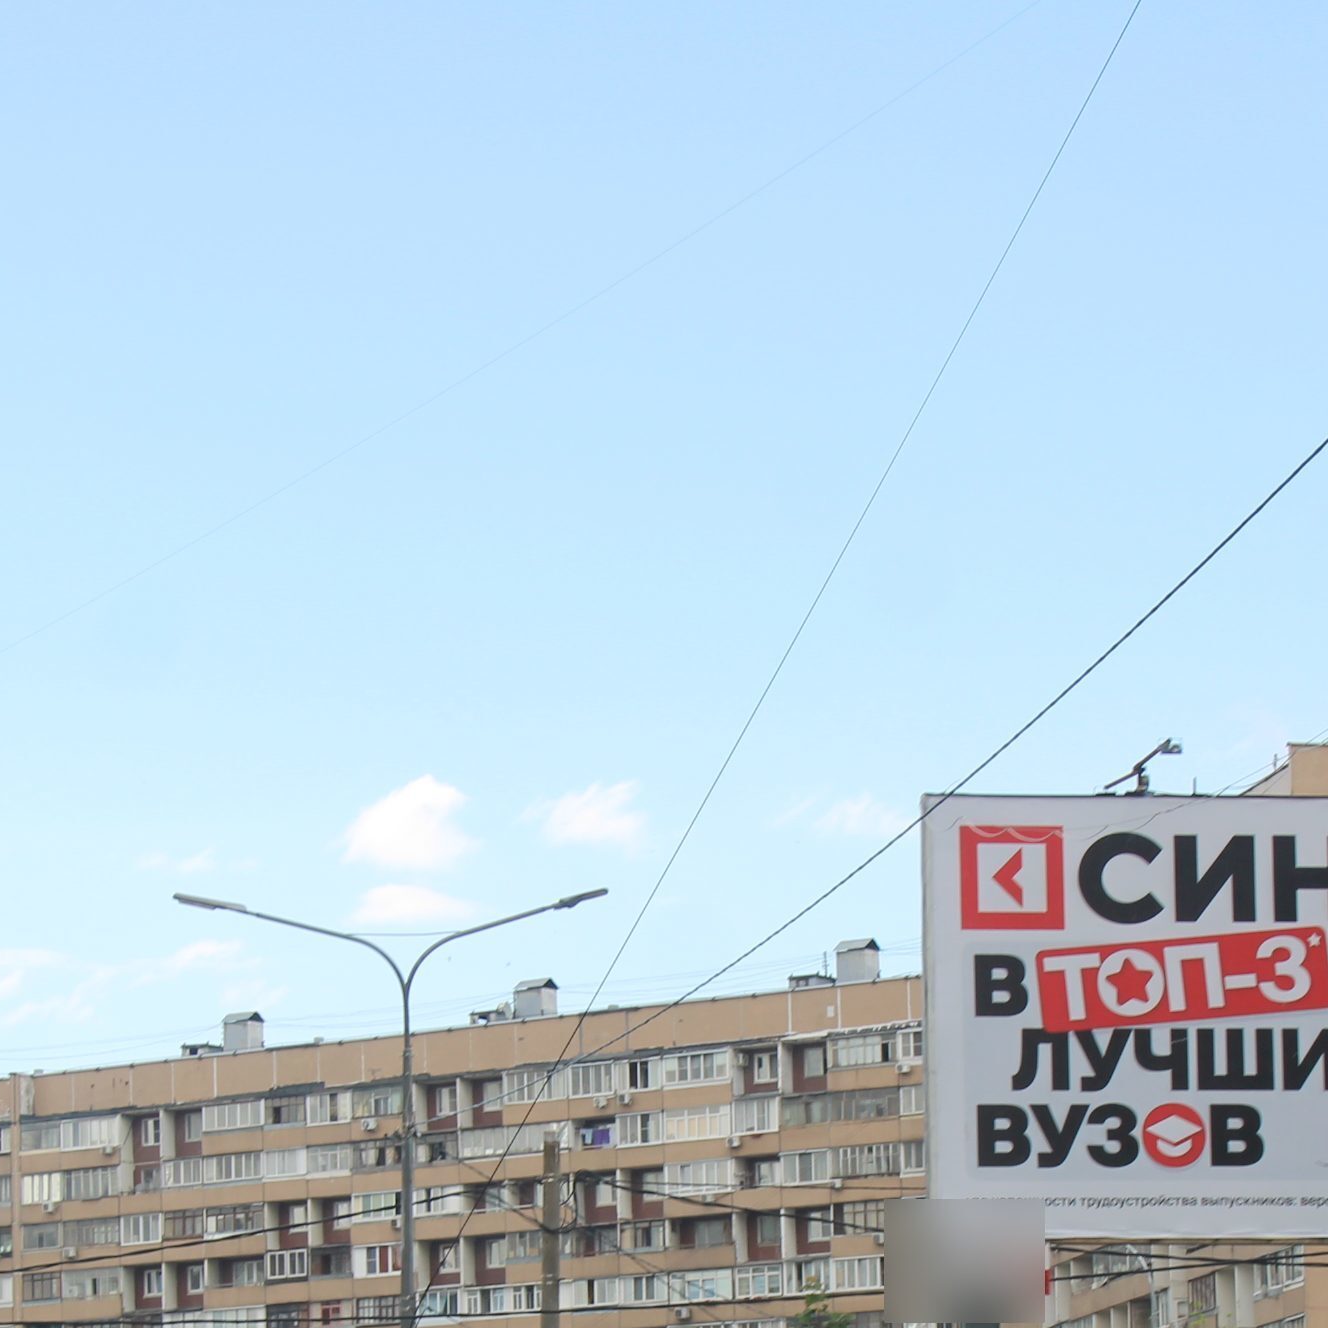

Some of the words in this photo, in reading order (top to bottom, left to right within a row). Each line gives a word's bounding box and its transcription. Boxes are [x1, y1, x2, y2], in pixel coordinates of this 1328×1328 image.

[974, 953, 1029, 1017] В
[976, 1102, 1265, 1168] ВУЗОВ
[1079, 1194, 1198, 1208] трудоустройства
[1200, 1195, 1297, 1208] выпускников:
